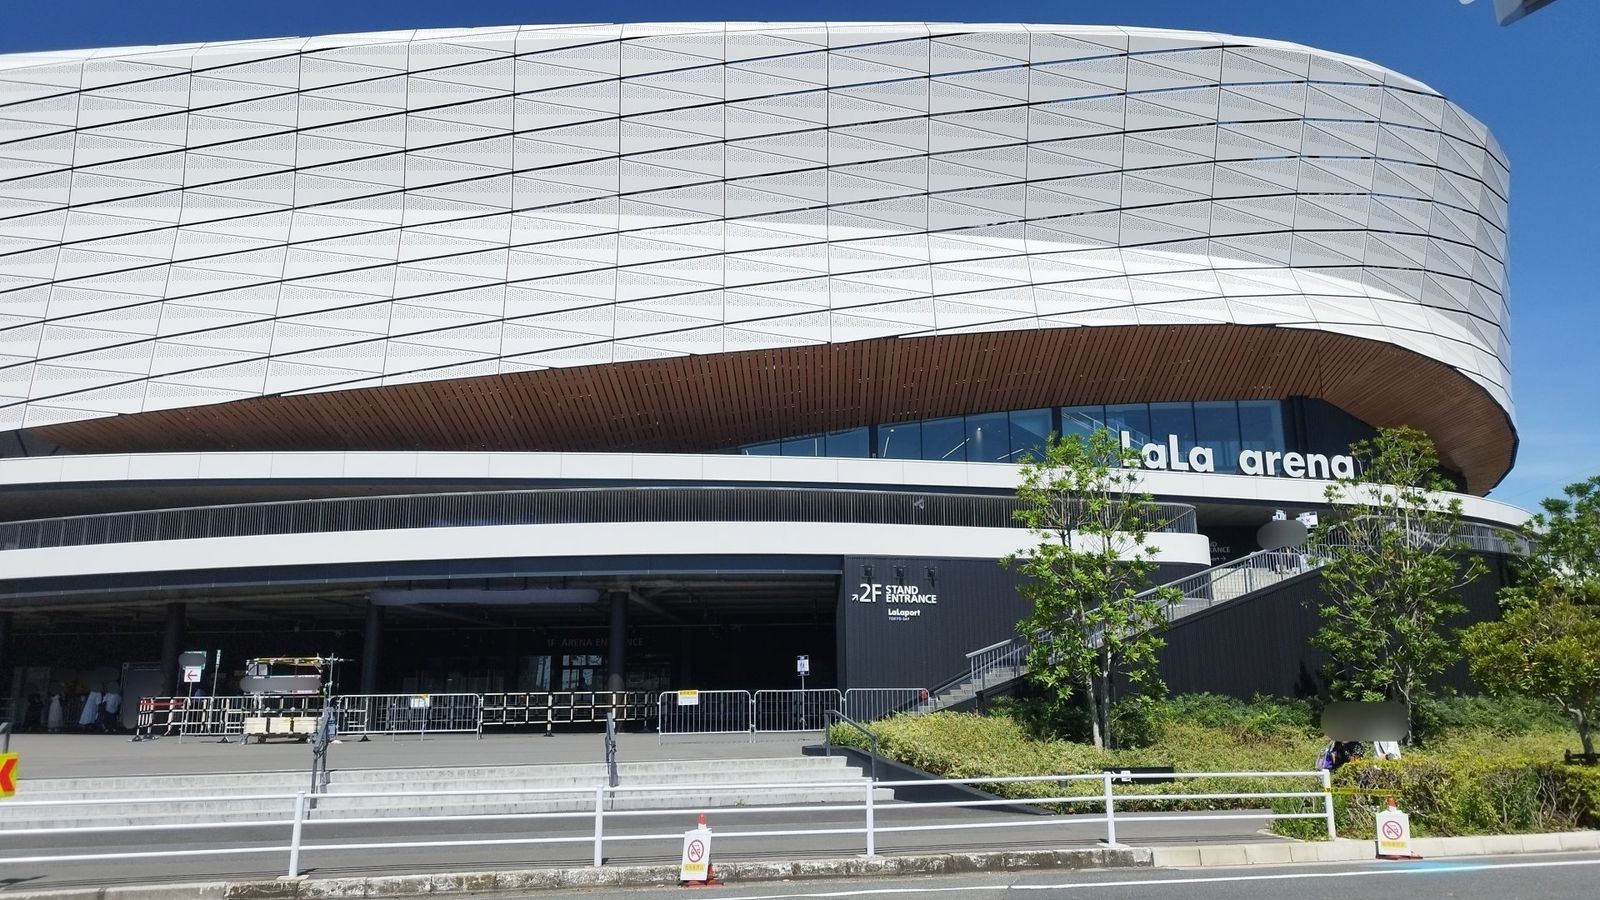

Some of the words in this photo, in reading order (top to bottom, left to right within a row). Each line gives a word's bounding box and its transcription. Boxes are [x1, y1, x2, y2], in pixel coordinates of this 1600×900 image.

[1120, 430, 1215, 473] LaLa
[1239, 449, 1355, 480] arena
[859, 583, 882, 602] 2F
[885, 585, 918, 594] STAND
[886, 594, 937, 603] ENTRANCE
[888, 608, 920, 617] LaLaport
[561, 638, 593, 647] ARENA
[595, 637, 644, 647] ENNCE
